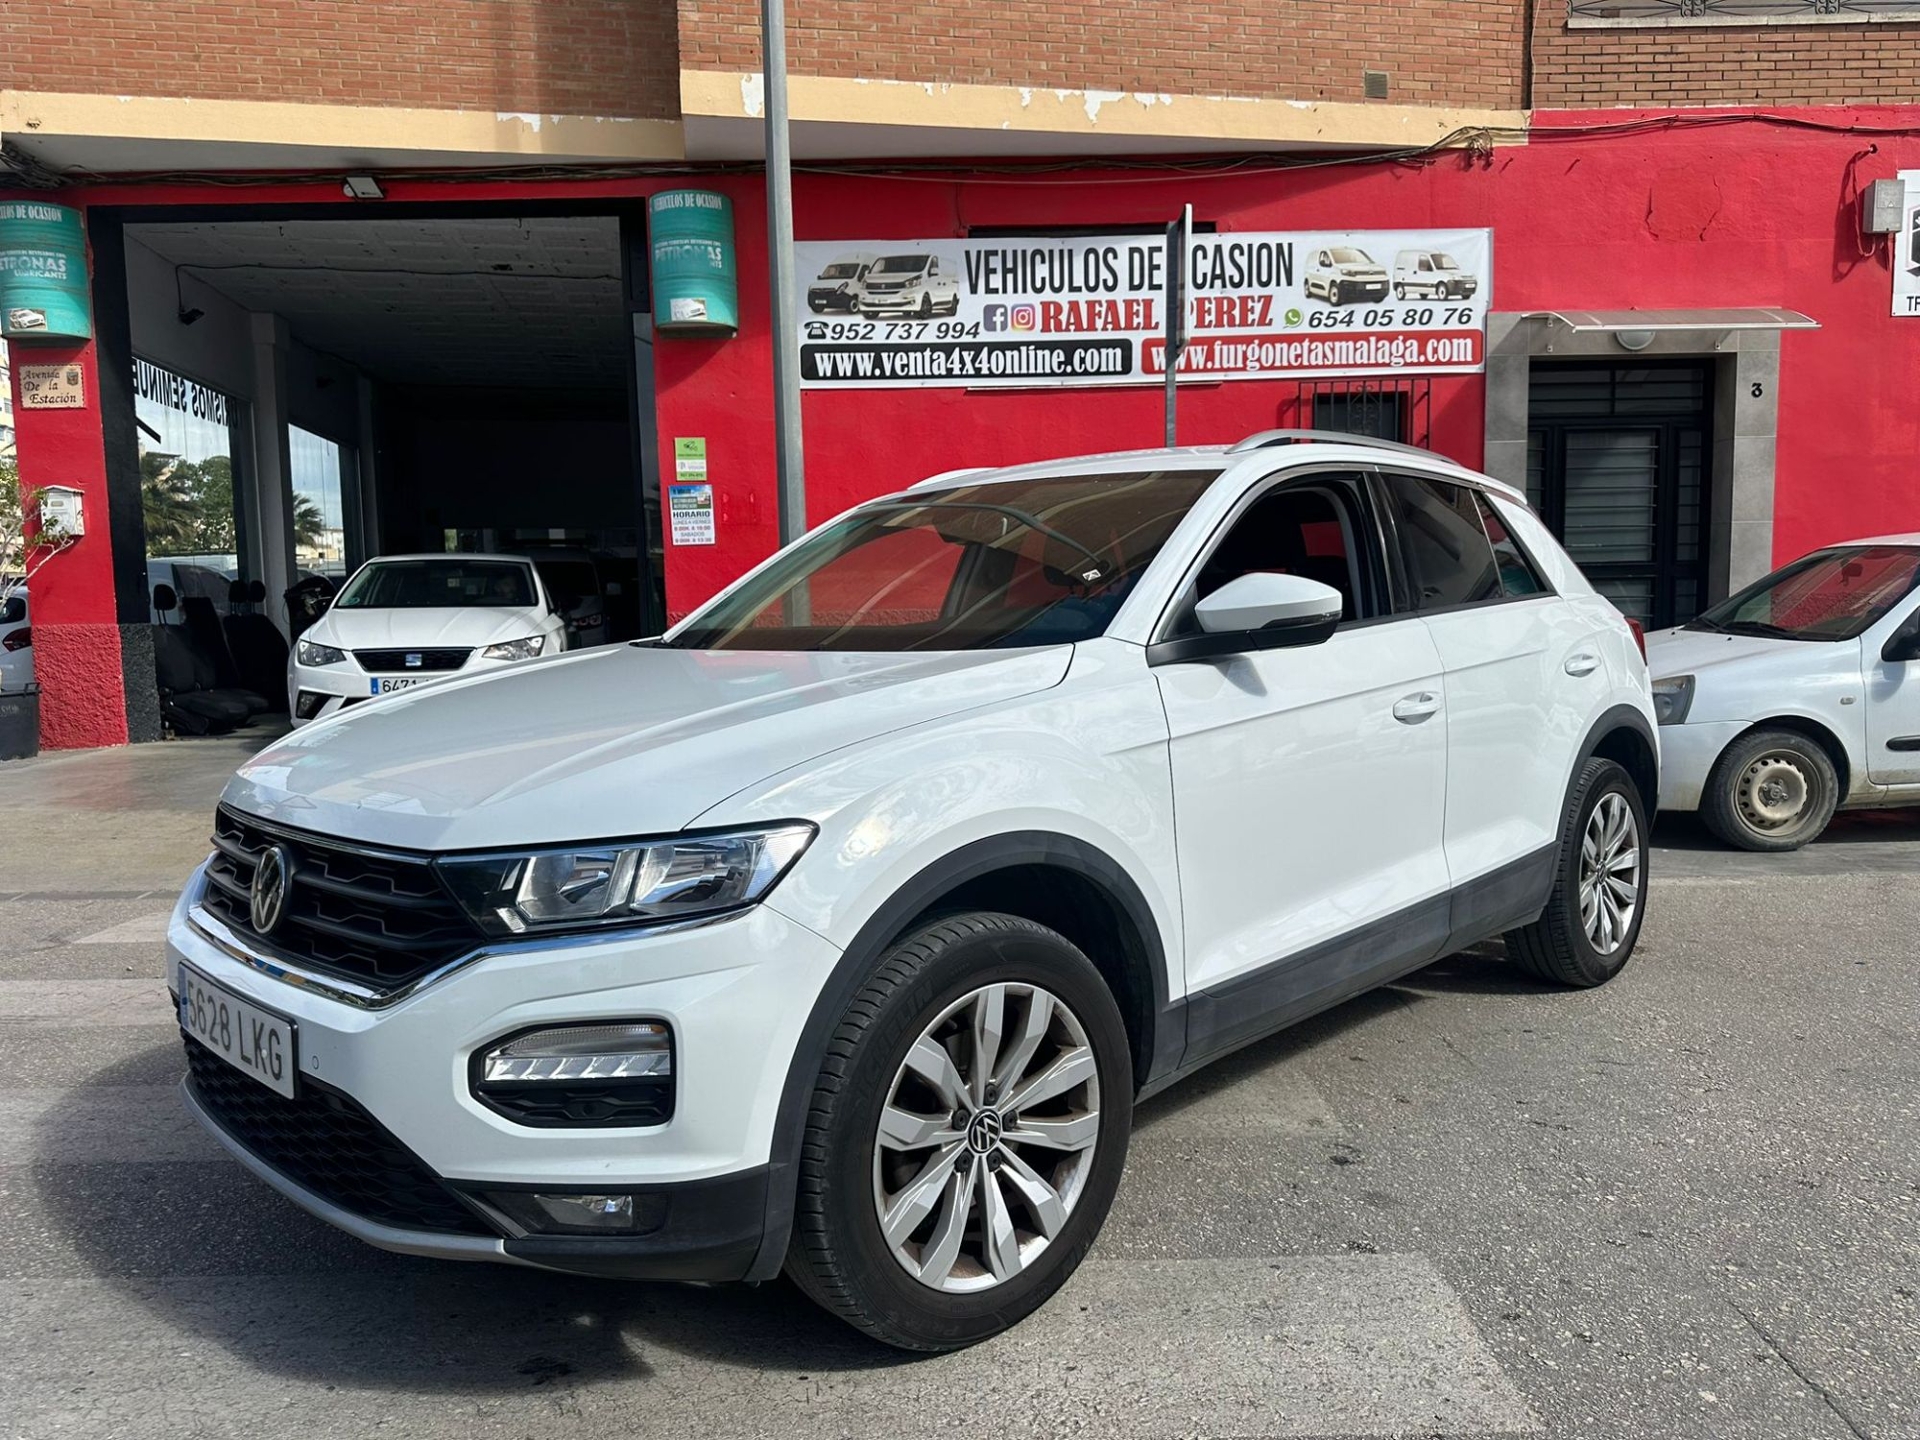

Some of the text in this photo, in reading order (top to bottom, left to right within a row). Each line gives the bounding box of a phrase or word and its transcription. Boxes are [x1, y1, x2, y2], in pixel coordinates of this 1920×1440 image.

[685, 193, 696, 208] DE
[16, 204, 27, 219] DE
[28, 206, 62, 222] OCASION
[965, 242, 1293, 295] VEHICULOS DE CASION
[1040, 295, 1274, 333] RAFAEL EREZ
[1308, 307, 1473, 329] 654 05 80 76
[830, 321, 981, 341] 952 737 994
[814, 345, 1123, 378] www.venta4x4online.com
[1150, 336, 1473, 371] www.furgonetasmalaga.com
[23, 368, 60, 380] Avenida
[24, 379, 58, 391] De la
[1751, 382, 1763, 398] 3
[30, 392, 77, 404] Estación
[672, 511, 711, 519] HORARIO
[188, 980, 283, 1081] 5628 LKG
